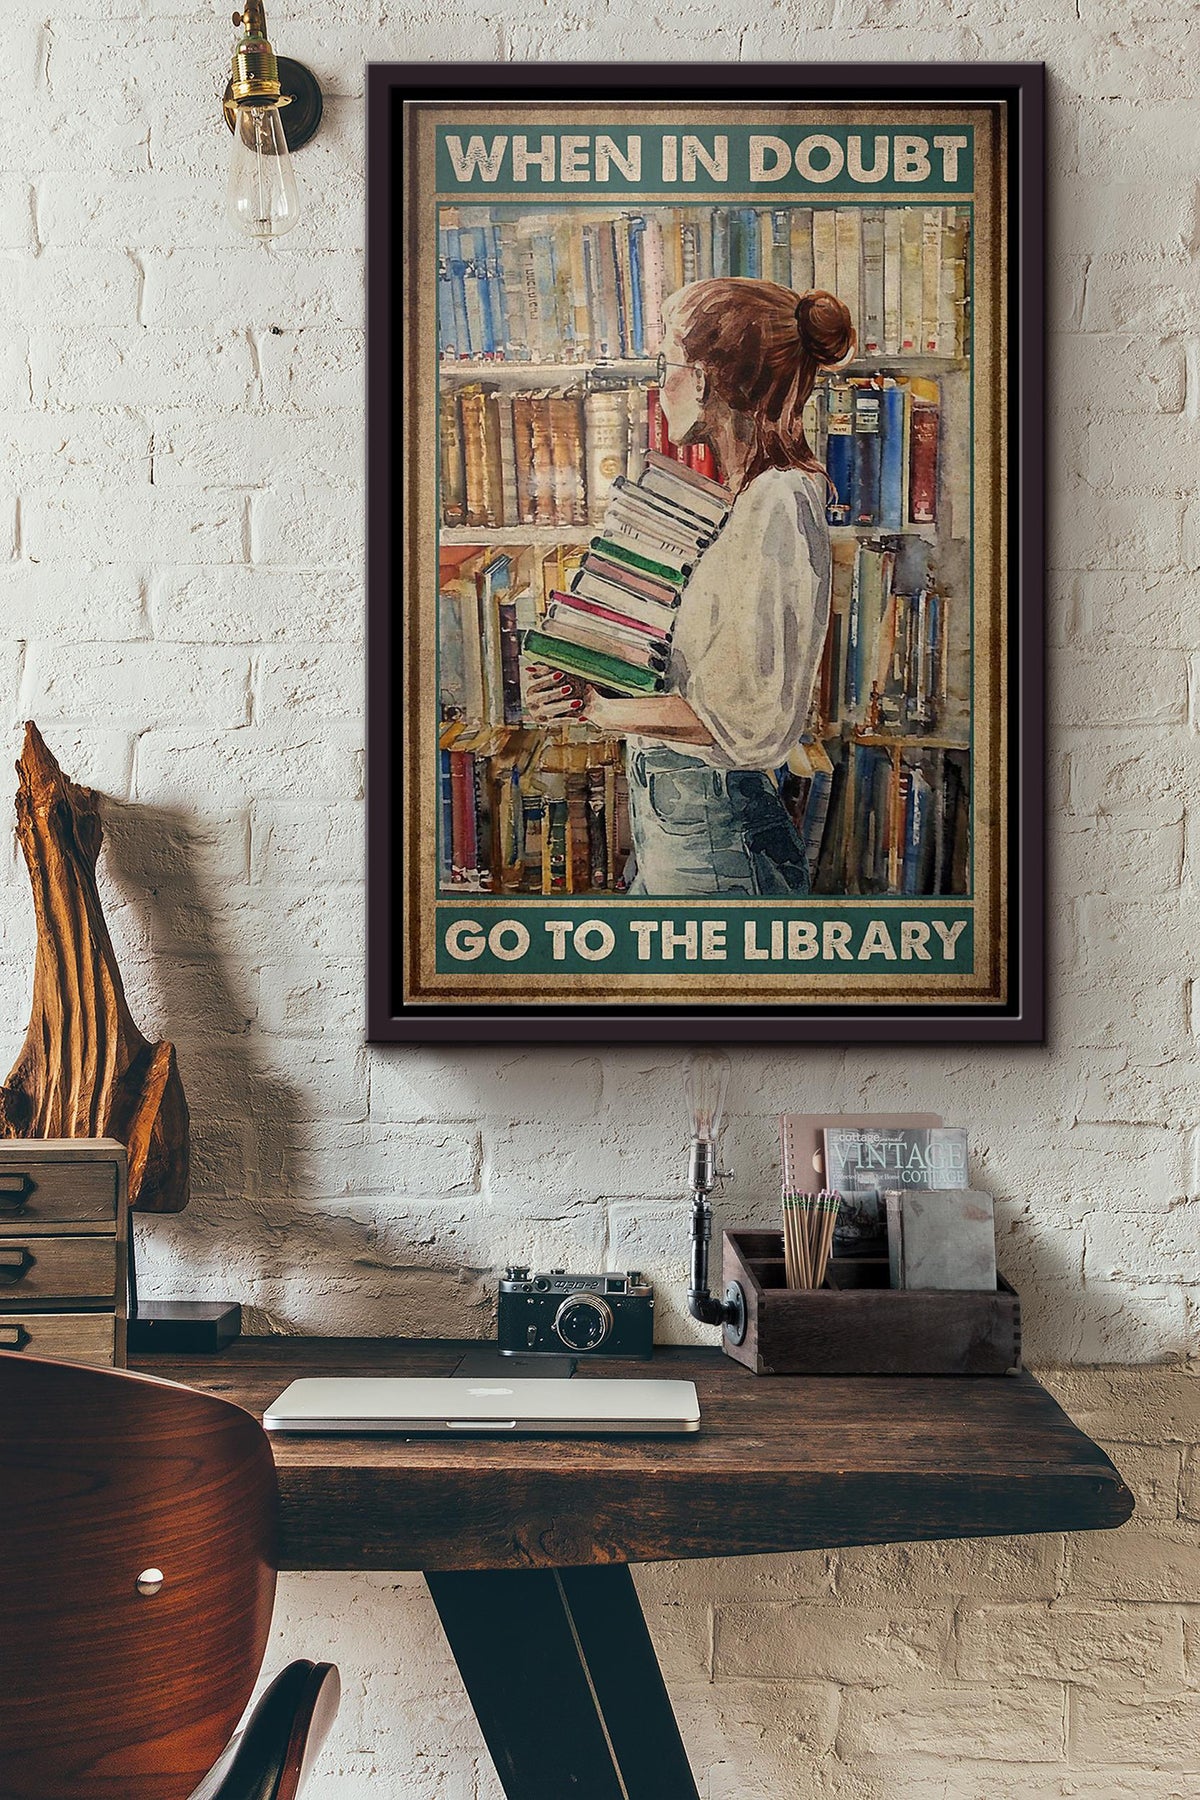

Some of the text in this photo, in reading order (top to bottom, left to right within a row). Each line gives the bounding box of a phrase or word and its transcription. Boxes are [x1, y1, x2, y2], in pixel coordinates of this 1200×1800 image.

[444, 134, 968, 184] WHEN IN DOUBT
[444, 919, 967, 961] GO TO THE LIBRARY
[838, 1132, 880, 1145] cottage
[831, 1142, 965, 1169] VINTAGE
[901, 1170, 965, 1183] COTTAGE
